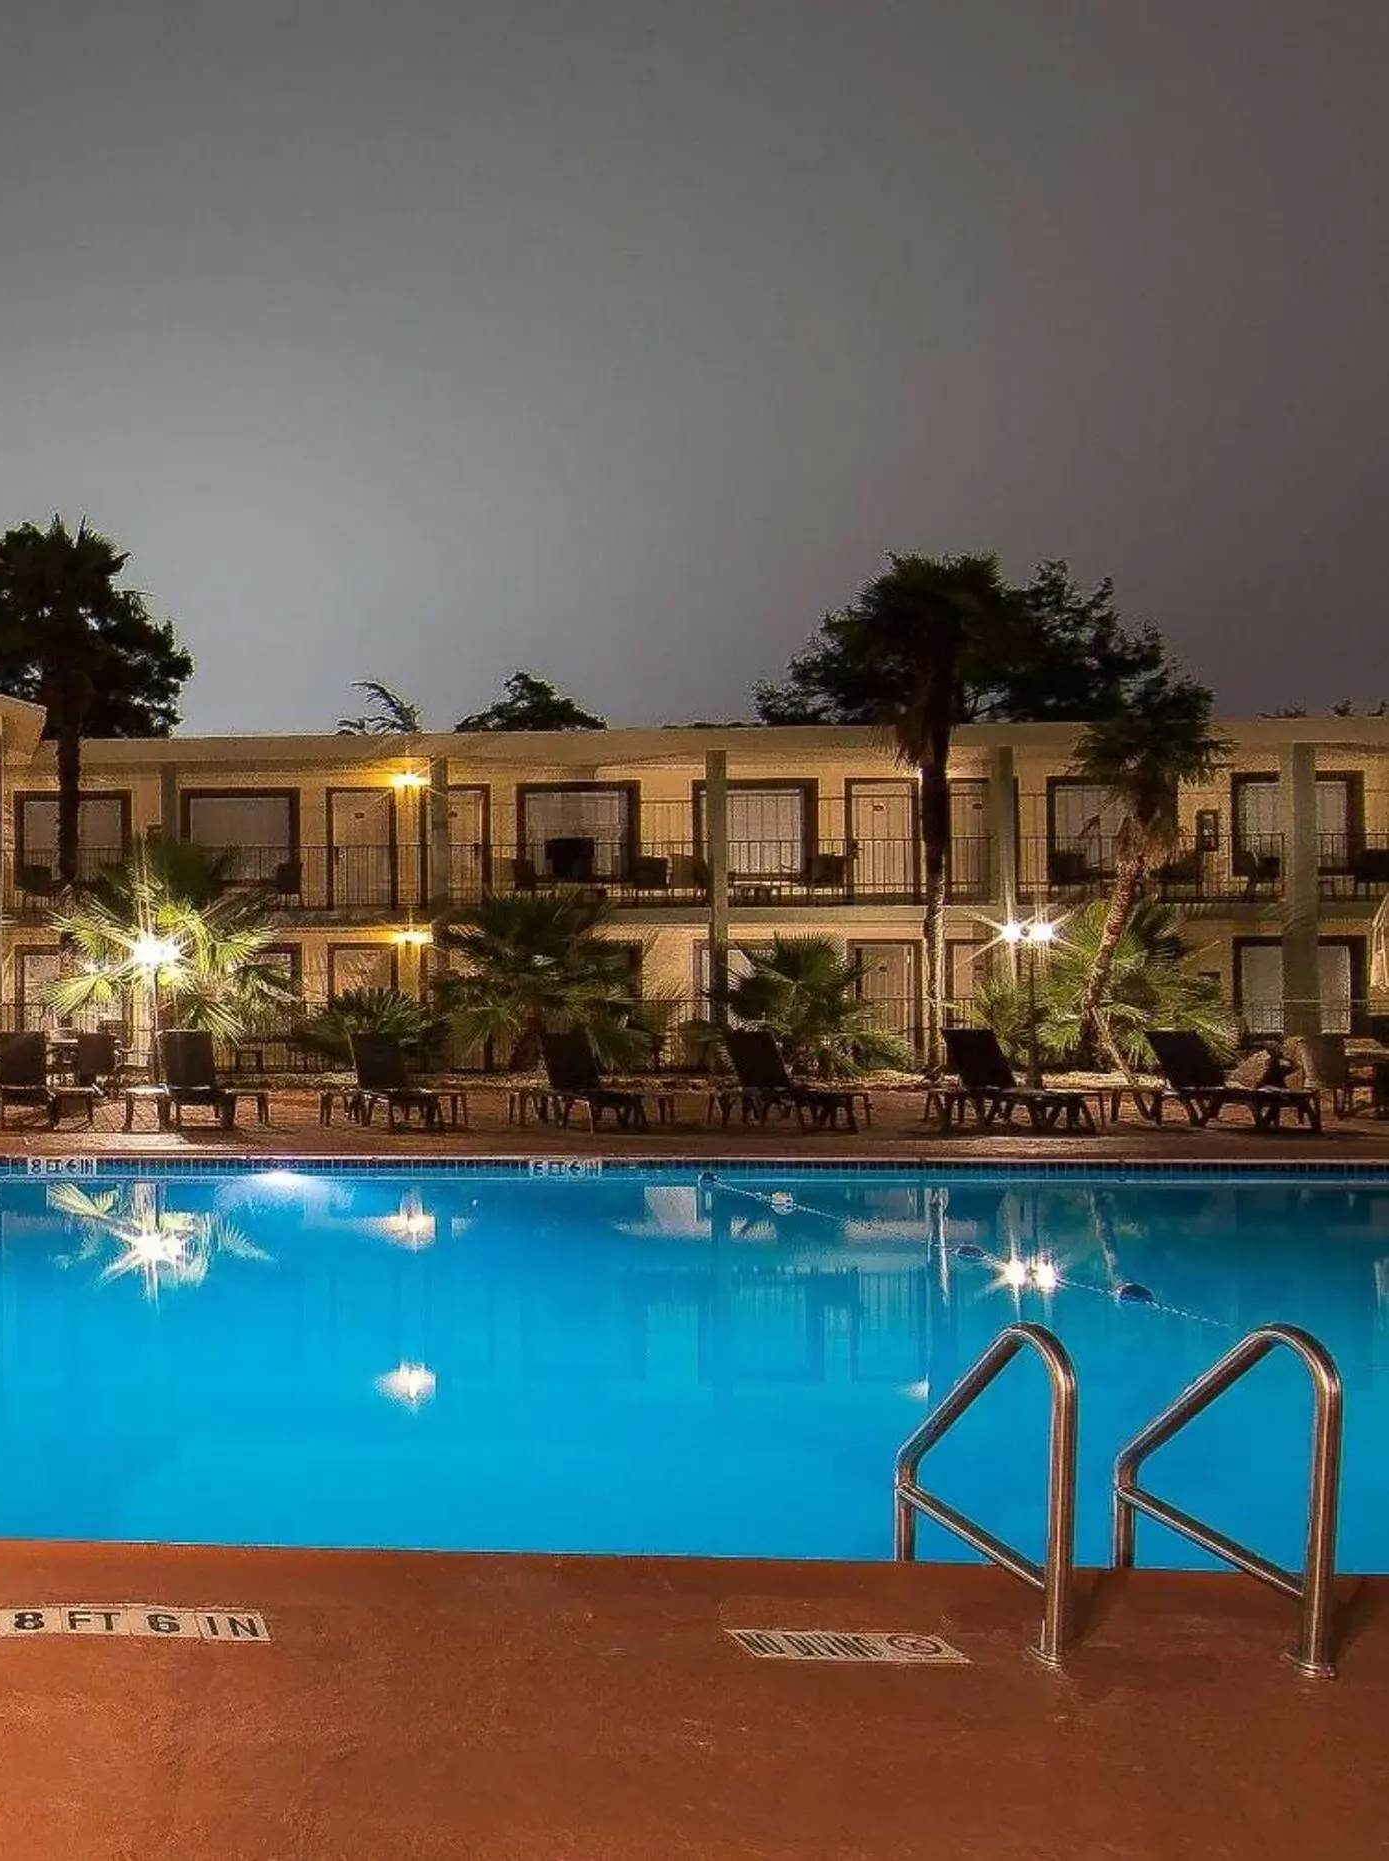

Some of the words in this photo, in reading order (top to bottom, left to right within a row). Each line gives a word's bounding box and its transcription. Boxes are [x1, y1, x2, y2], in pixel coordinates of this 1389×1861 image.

[14, 1611, 45, 1630] 8
[68, 1611, 121, 1631] FT
[146, 1614, 181, 1633] 6
[206, 1616, 259, 1637] IN
[737, 1632, 785, 1654] NO
[781, 1634, 884, 1657] DIVING
